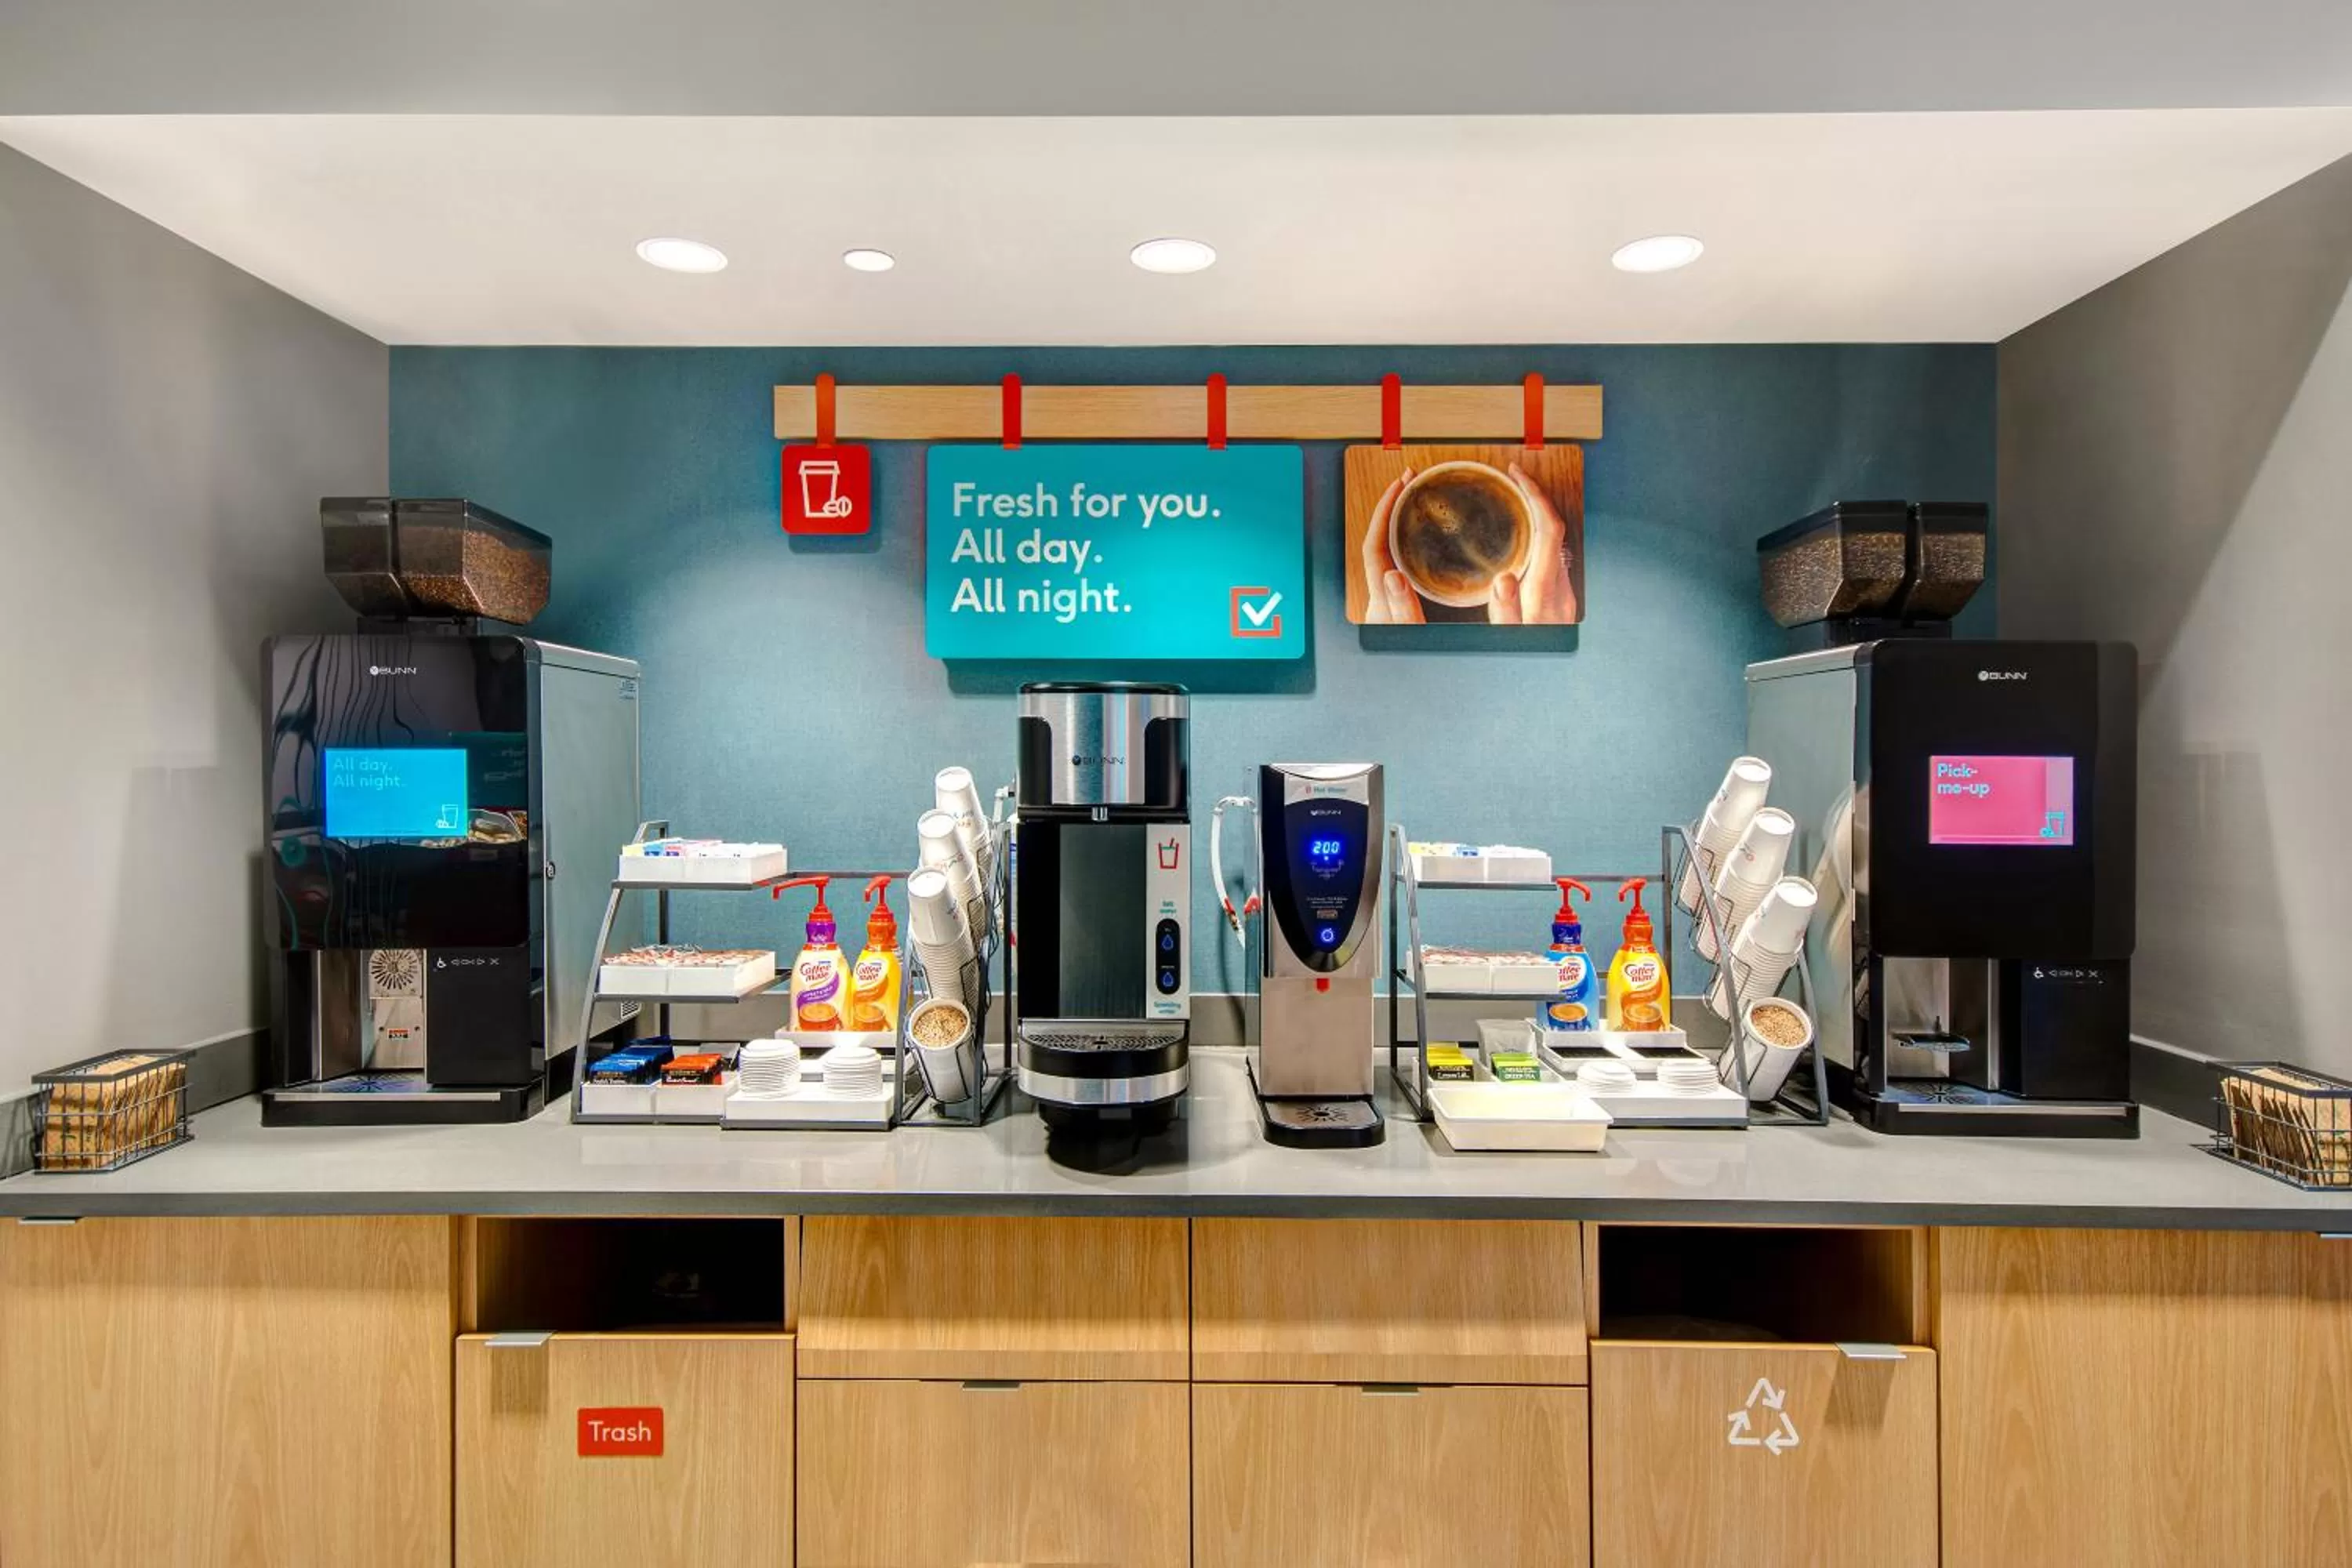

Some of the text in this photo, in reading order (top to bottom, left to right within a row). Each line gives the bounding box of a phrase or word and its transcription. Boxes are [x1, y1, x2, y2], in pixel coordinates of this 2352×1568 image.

[953, 482, 1221, 528] Fresh for you.
[950, 528, 1103, 575] All day.
[950, 577, 1132, 623] All night.
[379, 666, 417, 675] BUNN
[333, 756, 392, 775] All day.
[1936, 762, 1978, 778] Pick-
[332, 773, 405, 791] All night.
[1936, 782, 1990, 798] me-up
[1312, 840, 1340, 854] 200
[800, 962, 831, 975] Coffee
[856, 962, 882, 975] Coffee
[1557, 965, 1581, 975] offee
[1624, 964, 1656, 976] Coffee
[805, 972, 829, 982] mate
[587, 1420, 652, 1442] Trash
